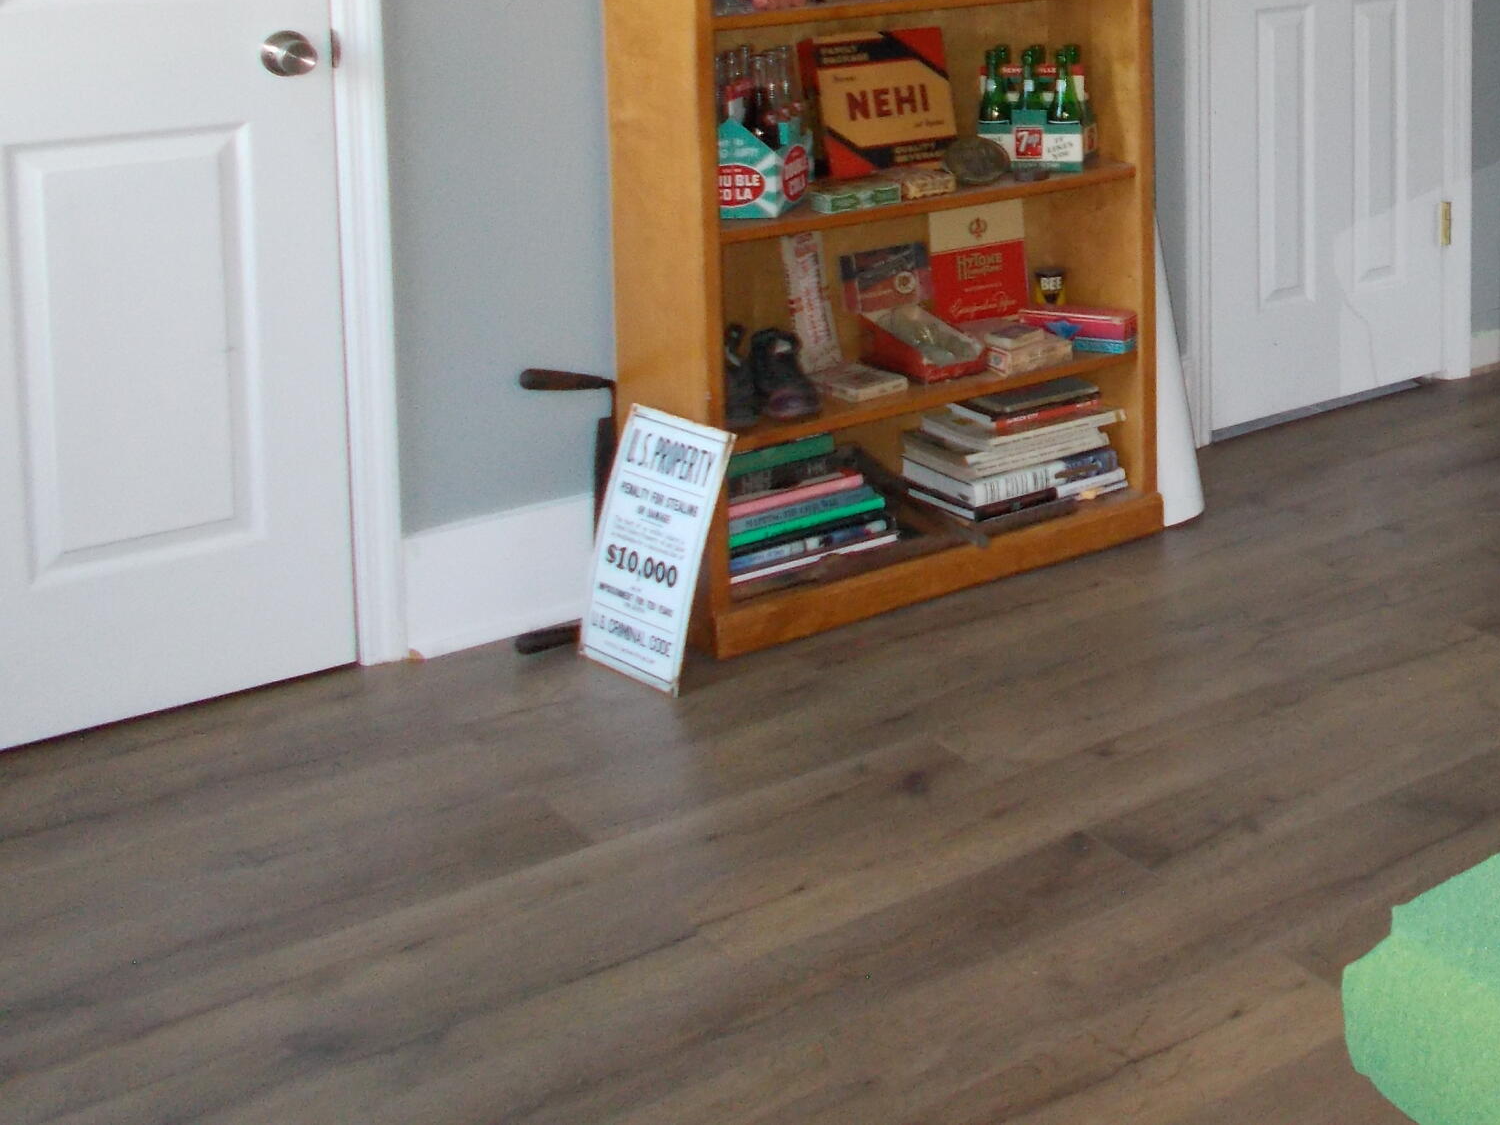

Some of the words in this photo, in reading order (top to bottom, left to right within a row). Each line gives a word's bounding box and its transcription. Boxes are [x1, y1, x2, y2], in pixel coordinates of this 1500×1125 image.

[845, 83, 930, 121] NEHI
[719, 174, 761, 187] UBLE
[1040, 276, 1063, 291] BEE
[606, 543, 677, 588] $10,000
